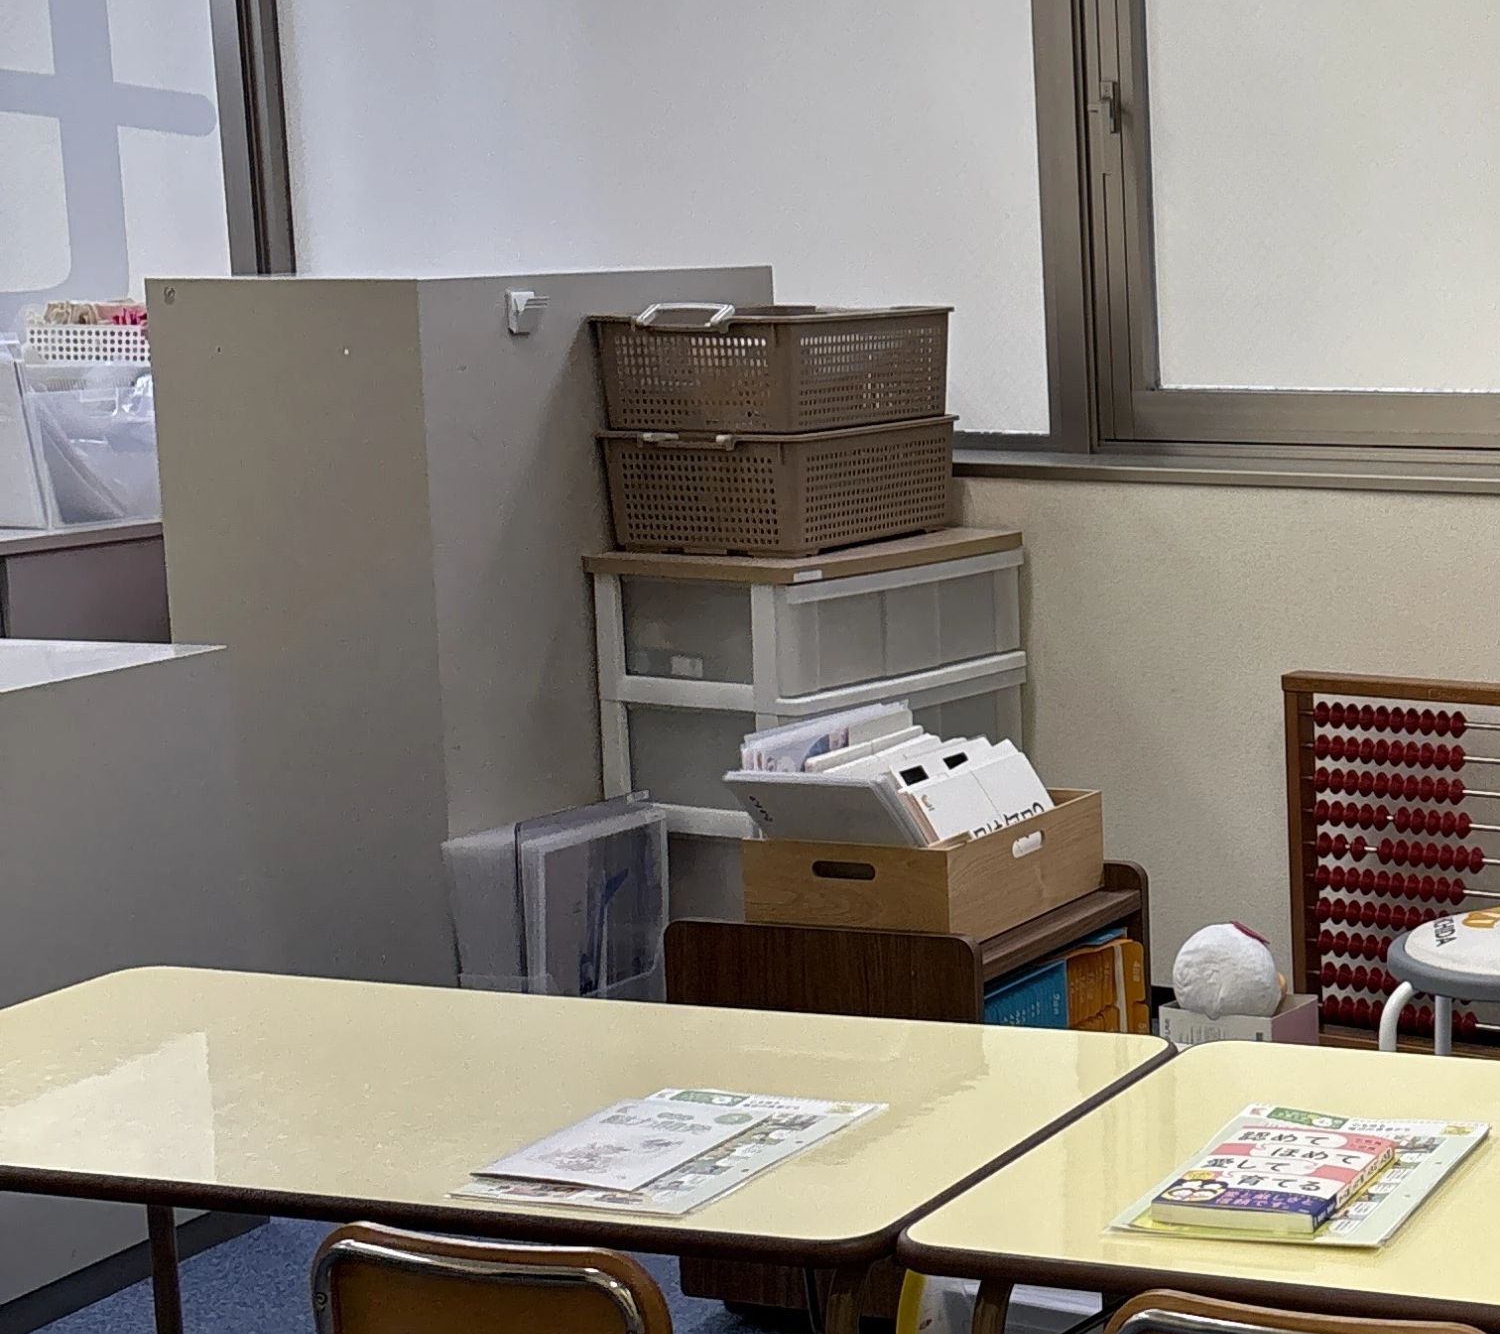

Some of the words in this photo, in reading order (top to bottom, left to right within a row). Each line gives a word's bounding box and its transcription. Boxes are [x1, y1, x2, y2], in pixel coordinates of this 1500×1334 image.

[1271, 1146, 1361, 1165] ほめて
[1237, 1174, 1321, 1192] 育てる
